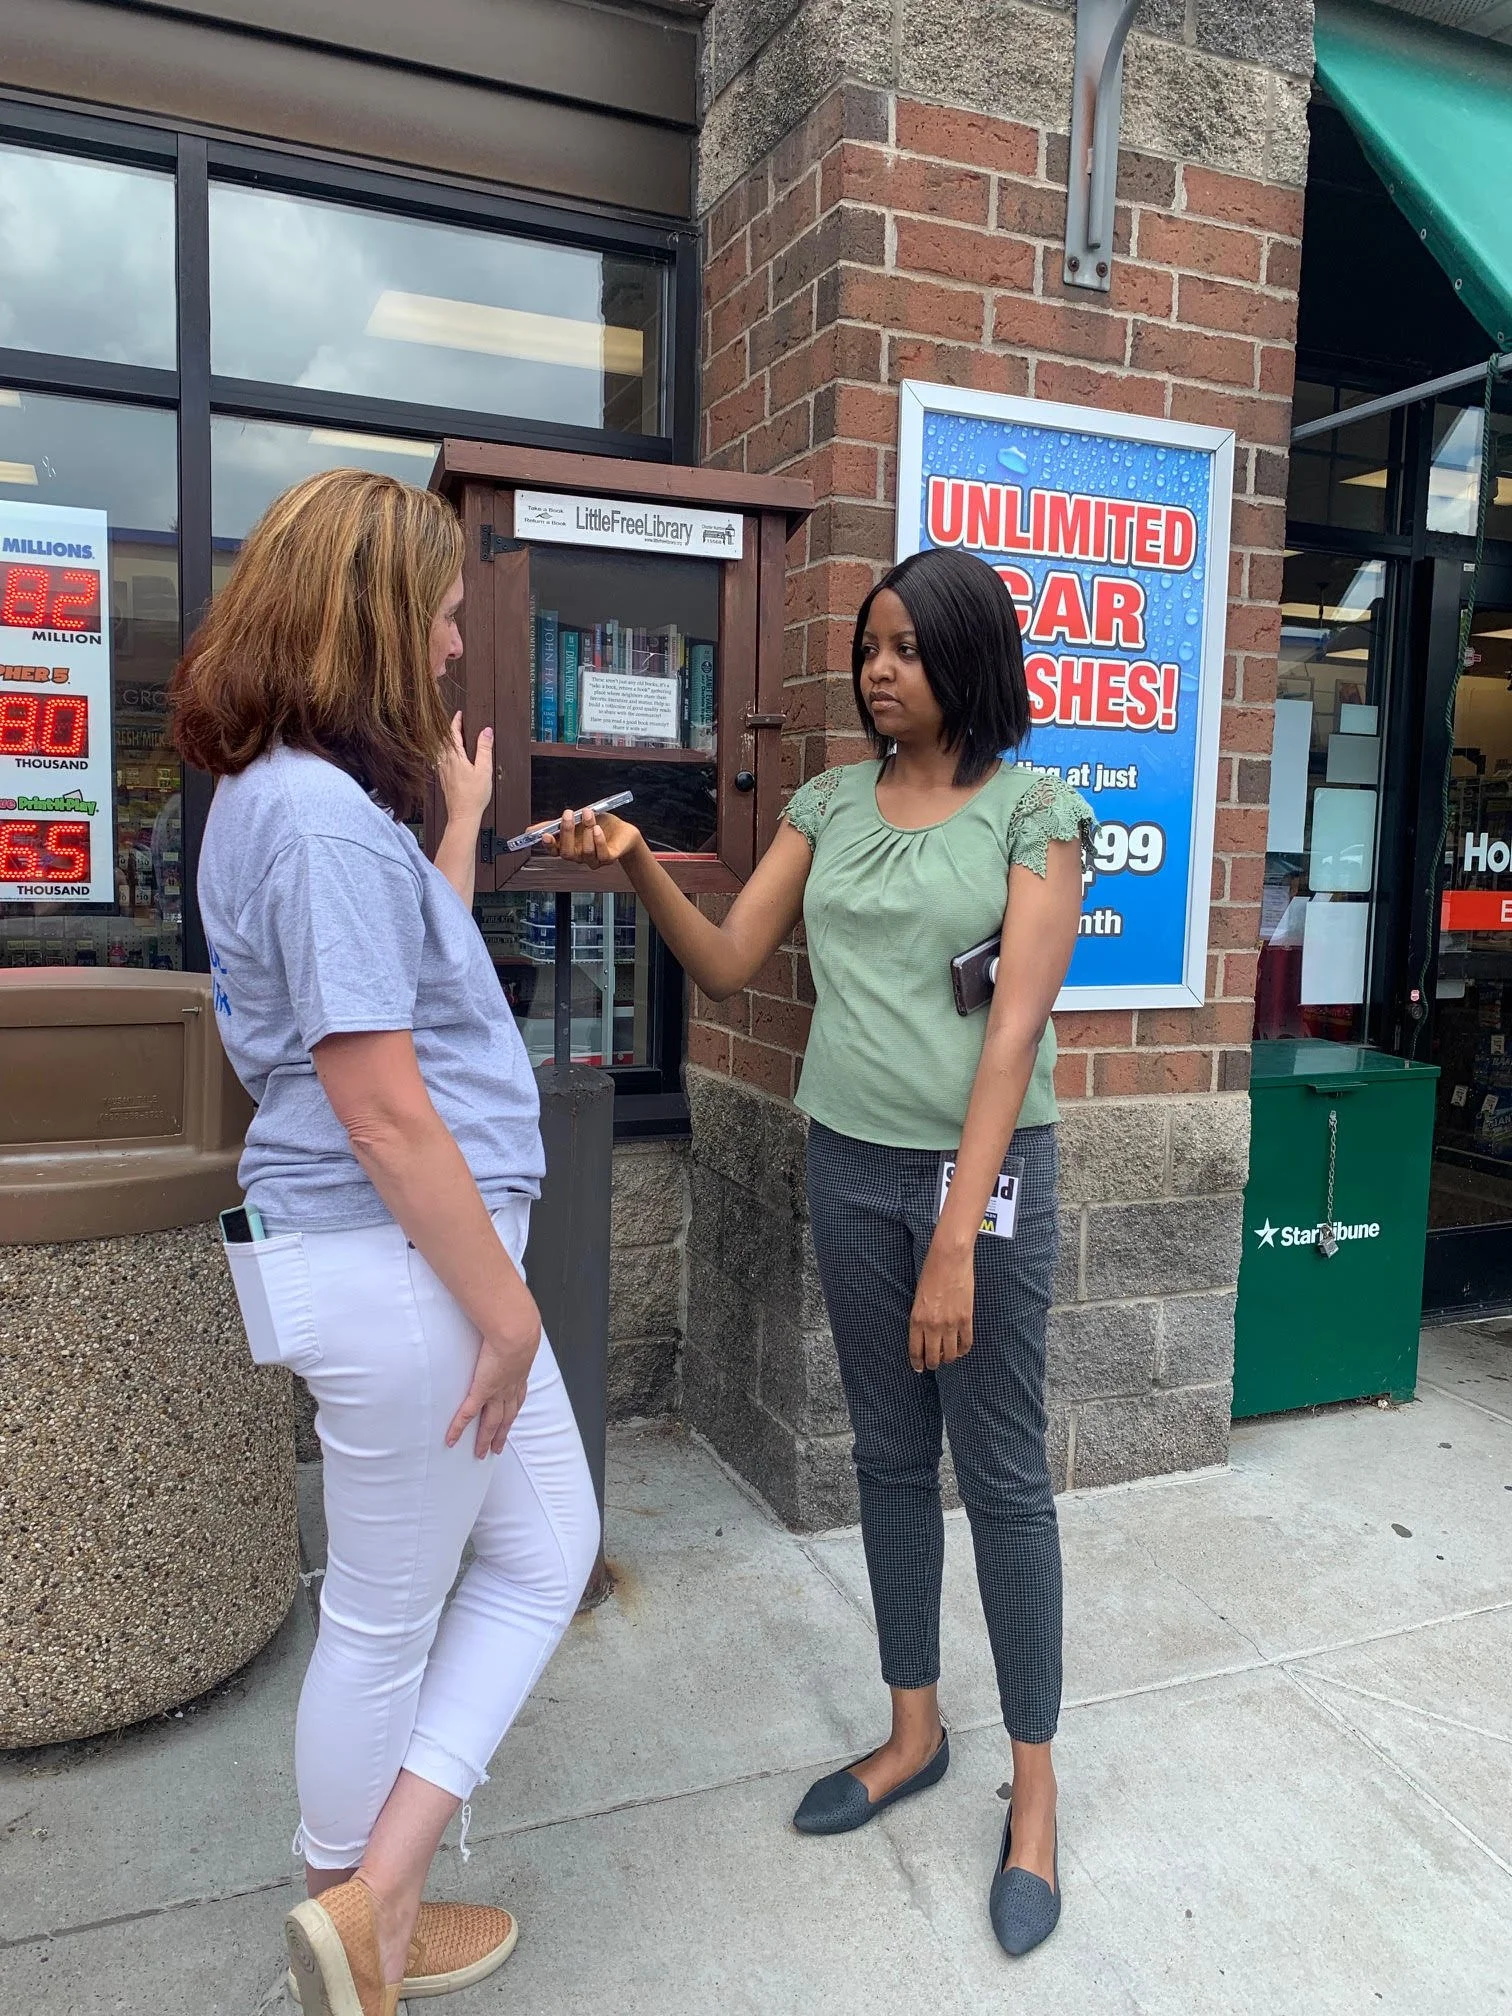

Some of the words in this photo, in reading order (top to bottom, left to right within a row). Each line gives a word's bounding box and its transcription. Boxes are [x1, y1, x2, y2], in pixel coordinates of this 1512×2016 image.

[576, 505, 693, 547] LittleFreeLibrary
[929, 477, 1198, 571] UNLIMITED
[3, 568, 98, 628] 82
[32, 630, 102, 645] MILLION
[544, 629, 554, 662] JOHN
[52, 667, 70, 685] 5
[544, 667, 554, 702] HART
[1024, 653, 1179, 731] SHES!
[15, 758, 89, 770] THOUSAND
[1067, 763, 1091, 787] at
[1093, 764, 1138, 792] just
[17, 885, 90, 896] THOUSAND
[1078, 909, 1122, 934] nth
[1280, 1221, 1380, 1247] StarTibune
